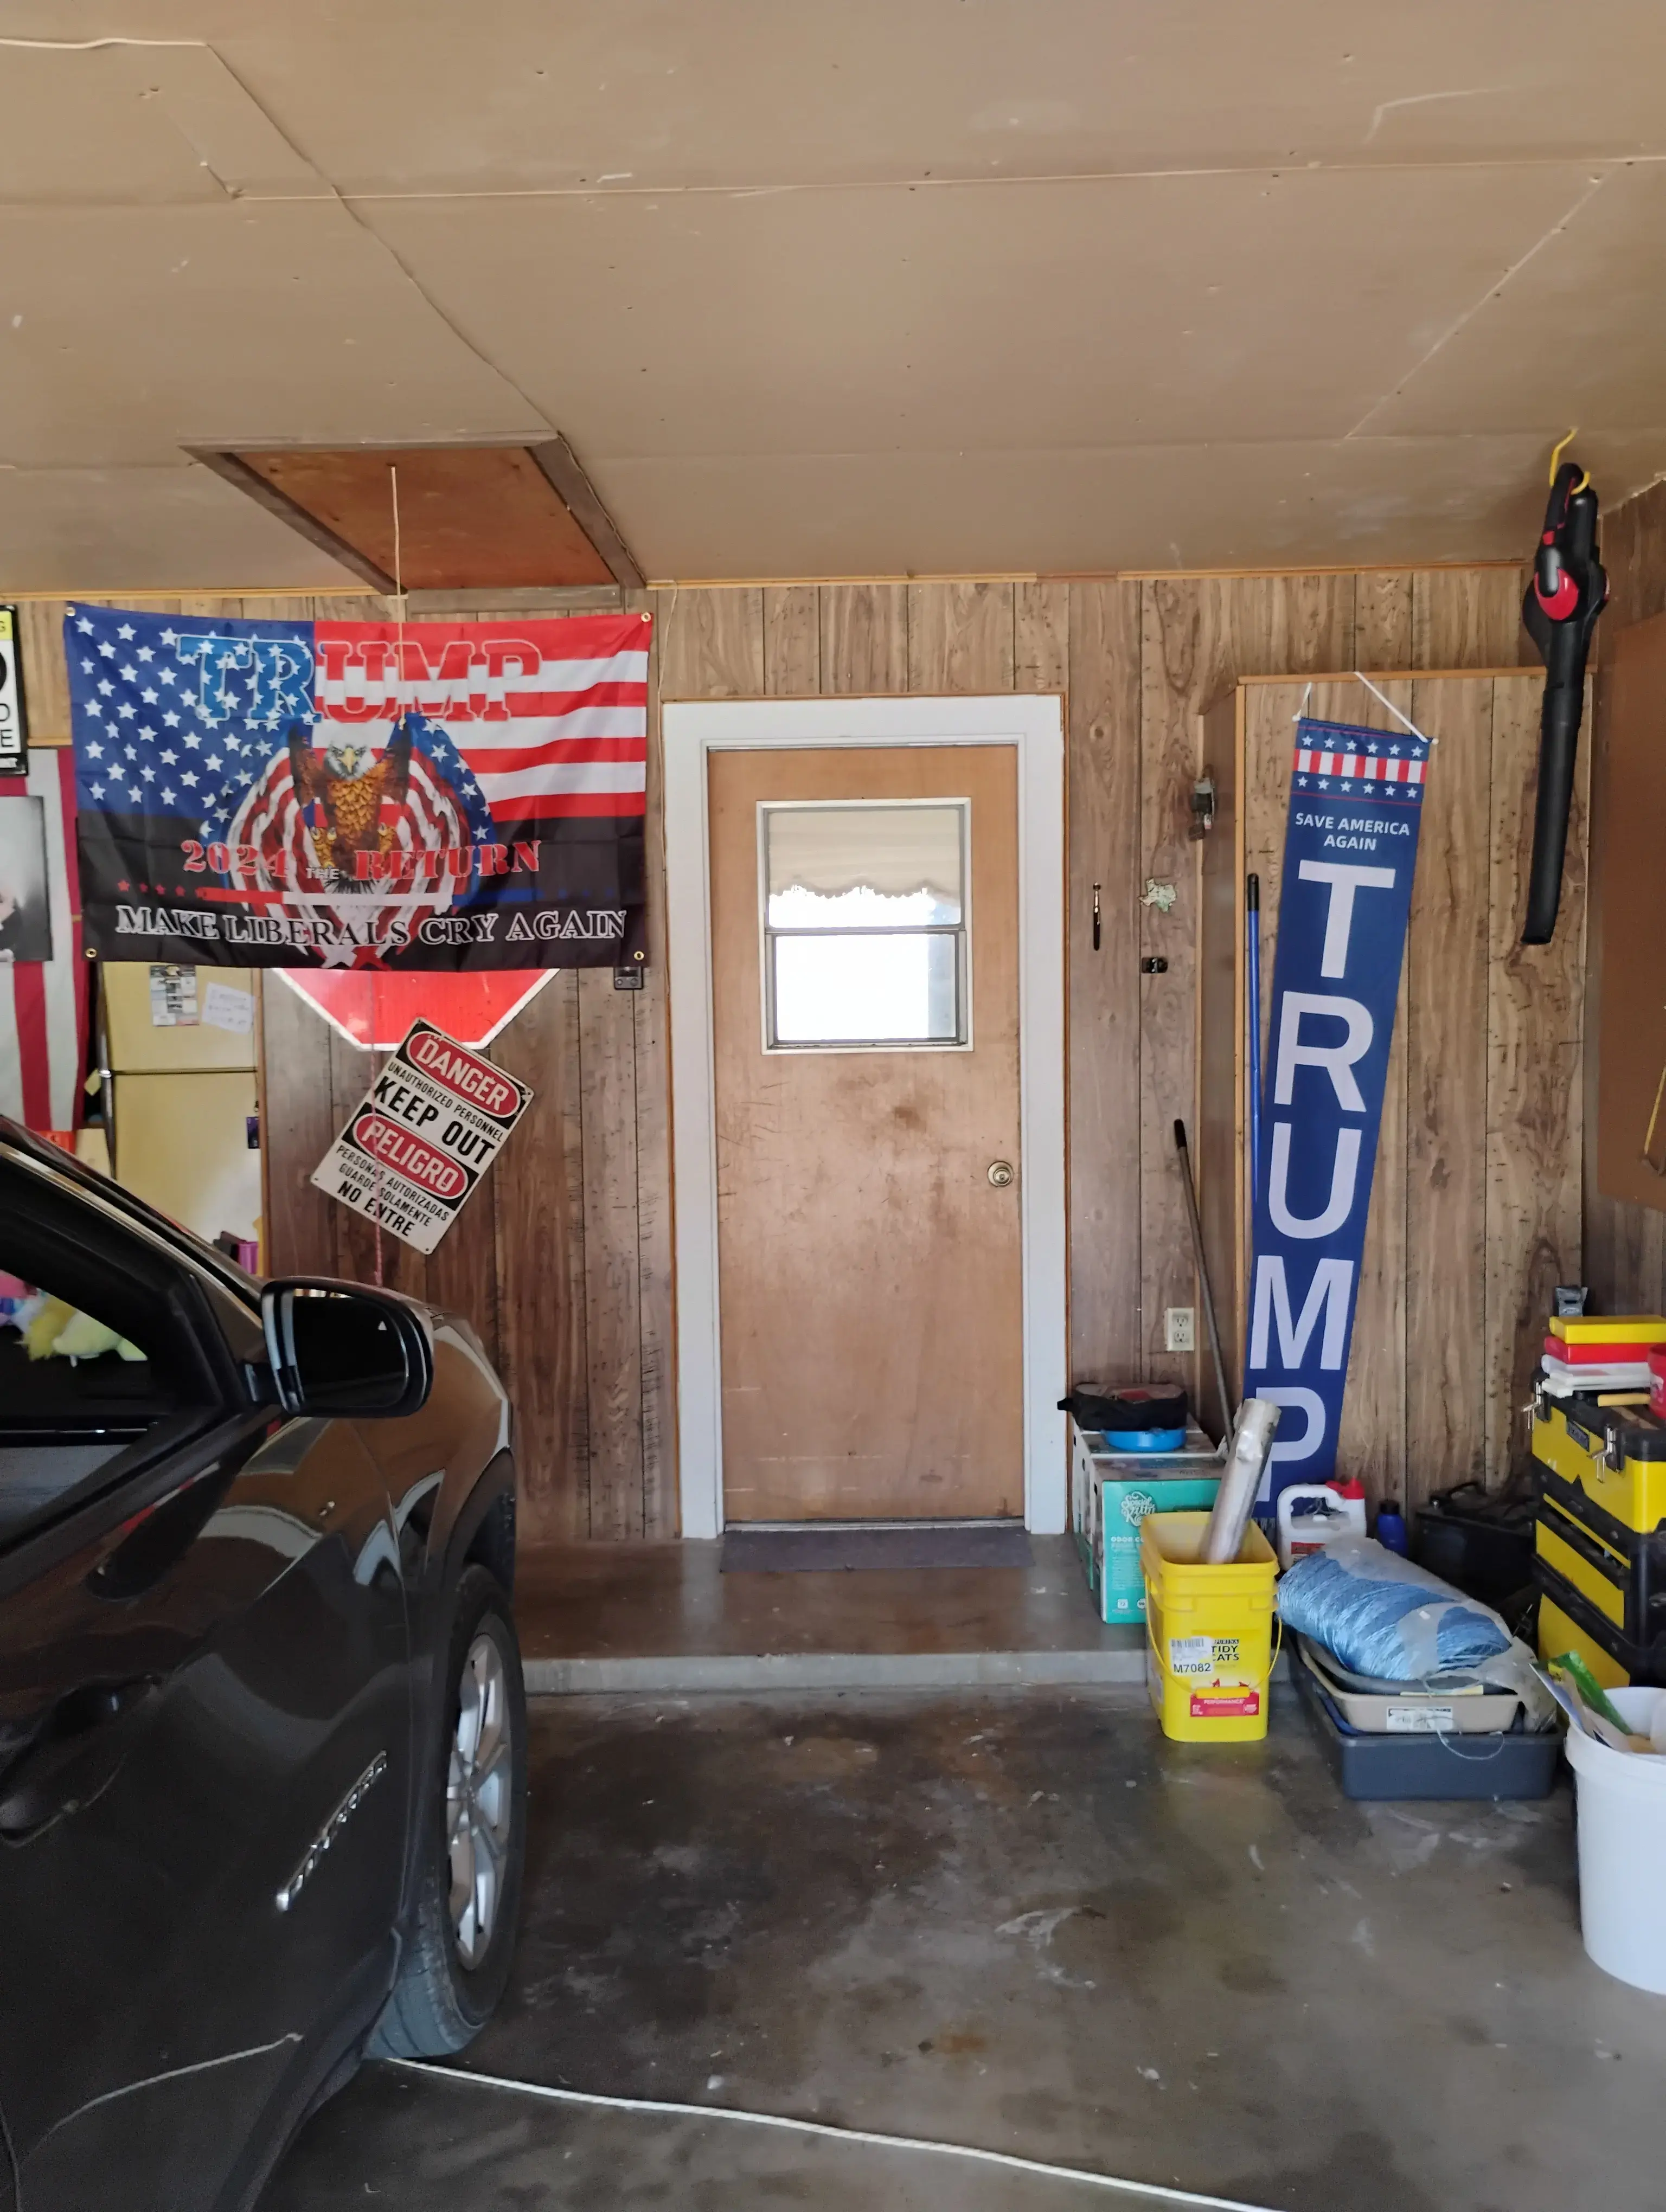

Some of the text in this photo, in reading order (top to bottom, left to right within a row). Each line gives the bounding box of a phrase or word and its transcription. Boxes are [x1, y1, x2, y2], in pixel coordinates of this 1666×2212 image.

[176, 634, 543, 724] TRUMP
[1295, 812, 1410, 836] SAVE AMERICA
[1323, 834, 1377, 851] AGAIN
[181, 840, 541, 881] 2024 THE RETURN
[116, 905, 626, 947] MAKE LIBERALS CRY AGAIN
[388, 1062, 504, 1142] UNAUTHORIZED PERSONNEL
[416, 1038, 509, 1111] DANGER
[373, 1075, 495, 1164] KEEP OUT
[336, 1144, 450, 1221] PERSONAS AUTORIZADAS
[361, 1121, 459, 1193] PELIGRO
[1250, 859, 1396, 1502] TRUMP
[337, 1181, 416, 1237] NO ENTRE
[339, 1163, 432, 1227] GUARDE SOLAMENTE
[1174, 1662, 1212, 1674] M7082
